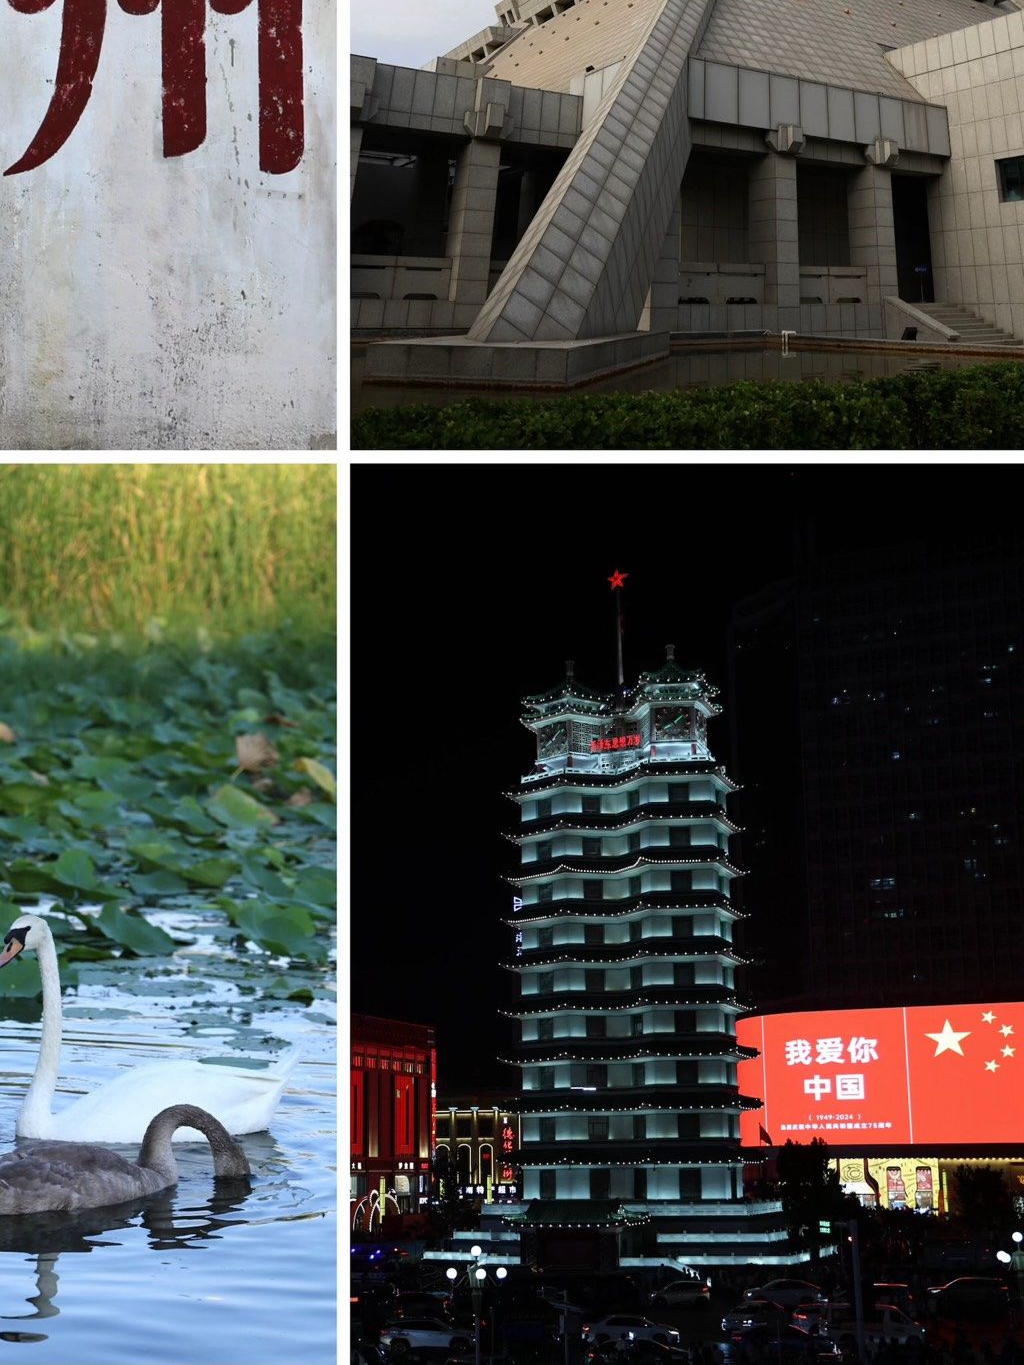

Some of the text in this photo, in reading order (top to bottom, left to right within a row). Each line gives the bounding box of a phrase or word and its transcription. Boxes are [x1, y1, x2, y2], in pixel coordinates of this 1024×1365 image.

[785, 1037, 879, 1066] 我爱你
[803, 1074, 865, 1101] 中国
